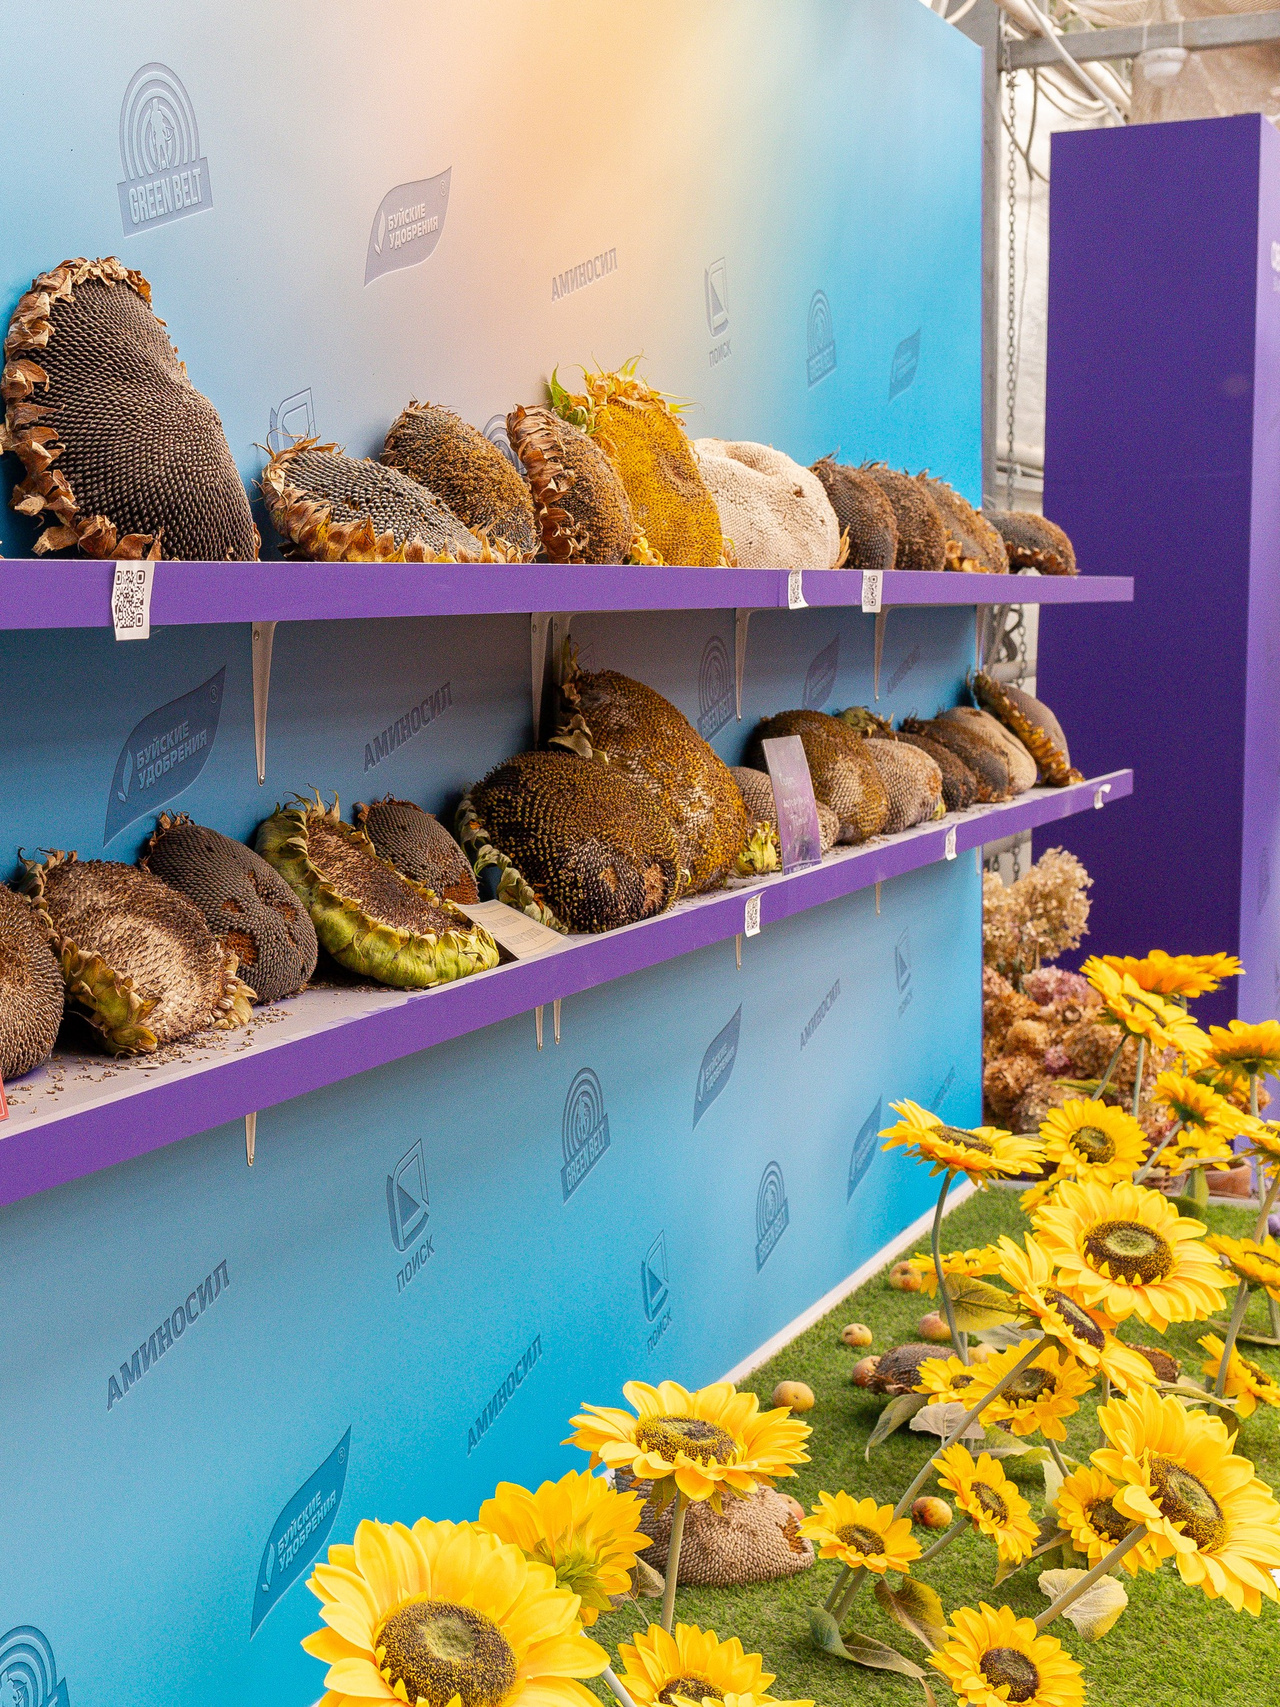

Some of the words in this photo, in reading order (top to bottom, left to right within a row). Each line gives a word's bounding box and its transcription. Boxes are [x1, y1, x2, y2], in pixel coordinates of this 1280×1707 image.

[129, 179, 173, 225] GREEN
[172, 168, 202, 211] BELT
[387, 203, 426, 232] БУЙСКИЕ
[389, 216, 439, 250] УДОБРЕНИЯ
[551, 247, 618, 303] АМИНОСИЛ
[136, 720, 190, 771] БУЙСКИЕ
[363, 681, 453, 775] АМИНОСИЛ
[138, 728, 208, 790] УДОБРЕНИЯ
[566, 1144, 590, 1191] GREEN
[588, 1123, 606, 1163] BELT
[396, 1234, 436, 1295] ПОИСК
[106, 1258, 231, 1413] АМИНОСИЛ
[647, 1306, 673, 1357] ПОИСК
[466, 1333, 543, 1458] АМИНОСИЛ
[277, 1490, 322, 1558] БУЙСКИЕ
[279, 1489, 337, 1573] УДОБРЕНИЯ
